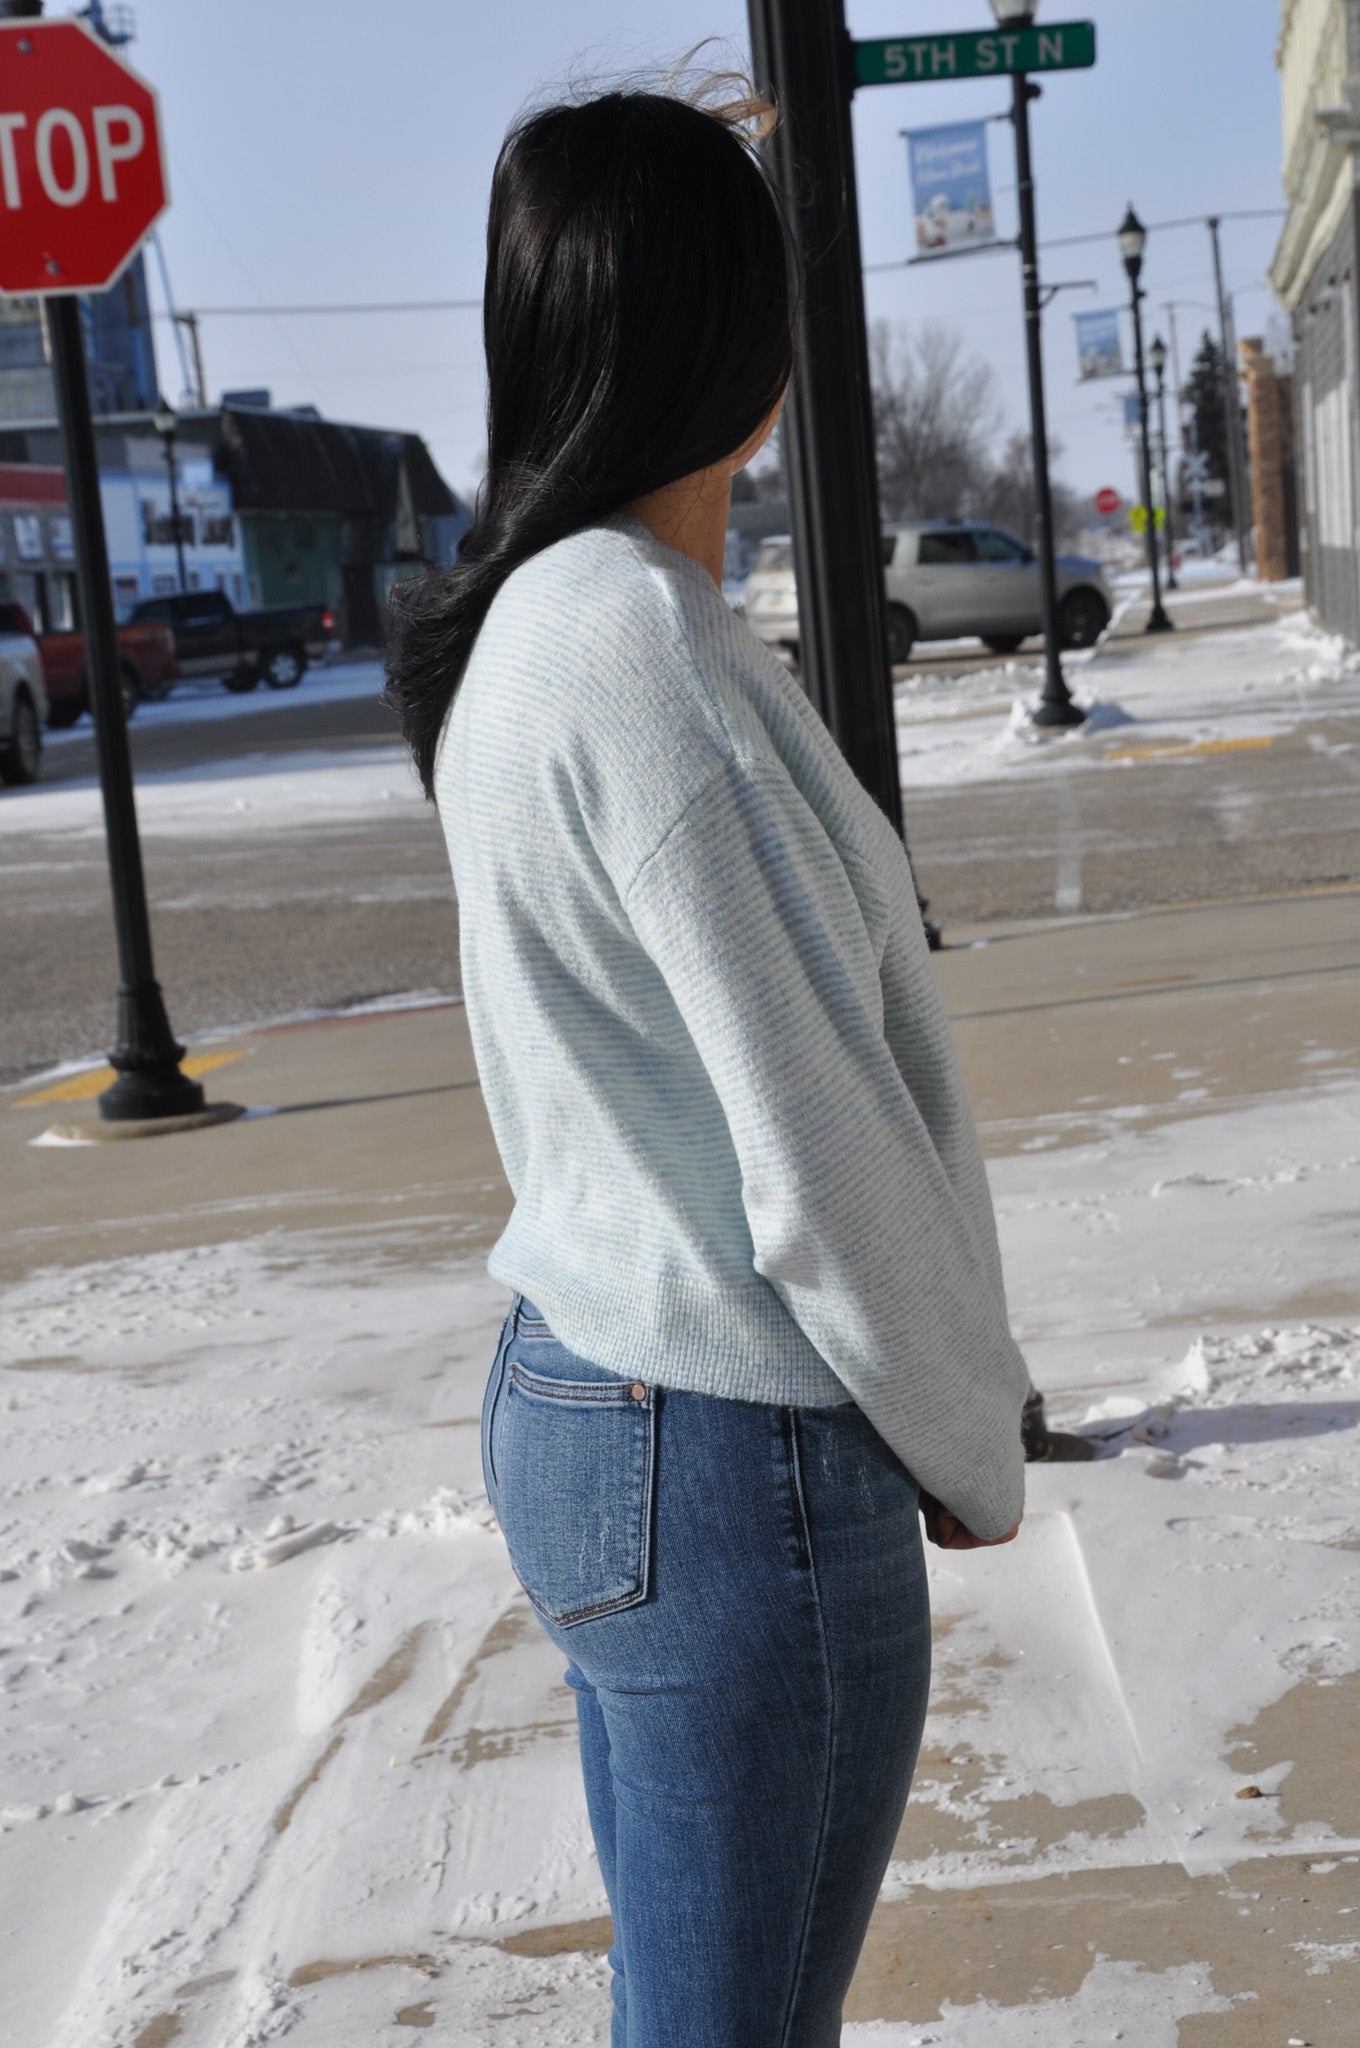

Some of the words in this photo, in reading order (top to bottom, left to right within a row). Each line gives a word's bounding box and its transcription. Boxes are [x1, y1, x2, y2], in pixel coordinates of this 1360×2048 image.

[884, 42, 956, 77] 5TH
[975, 35, 1019, 70] ST
[1038, 32, 1063, 65] N
[0, 104, 145, 209] TOP
